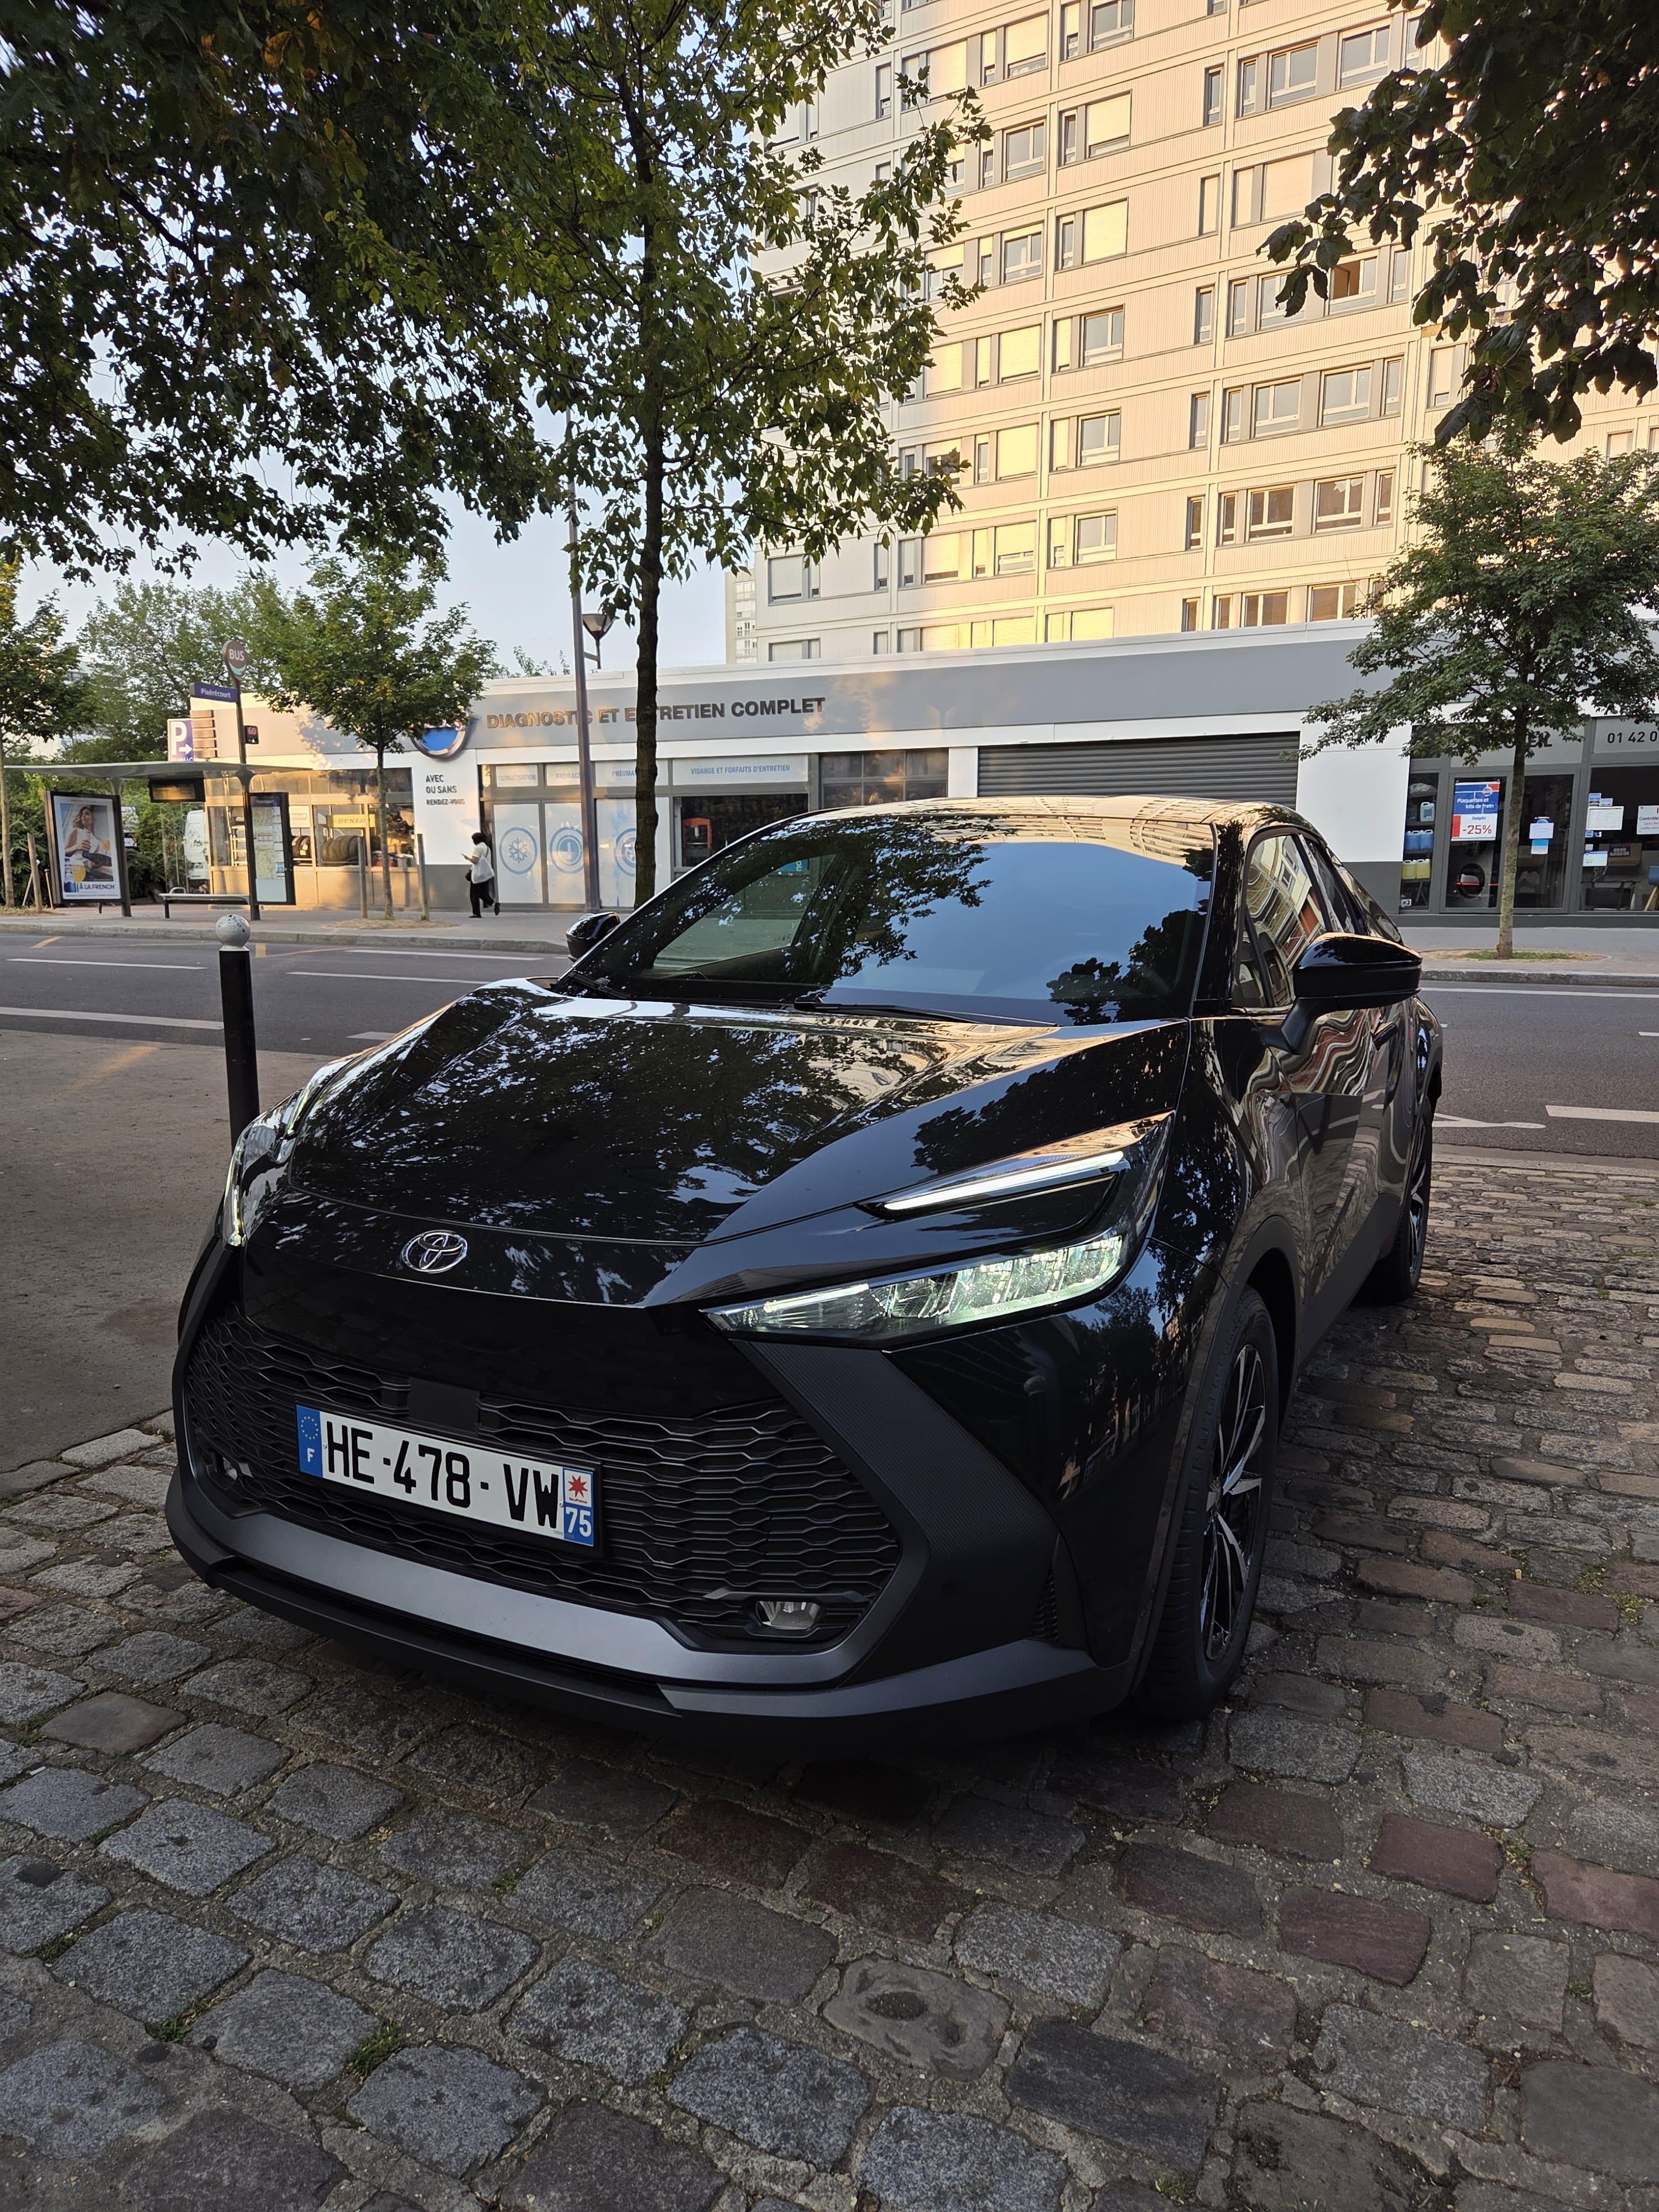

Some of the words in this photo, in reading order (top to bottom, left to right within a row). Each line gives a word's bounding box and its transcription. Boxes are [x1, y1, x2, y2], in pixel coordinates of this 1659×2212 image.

[229, 649, 244, 661] BUS
[201, 688, 231, 698] Pixérécourt
[598, 708, 619, 723] ET
[625, 703, 726, 722] ERETIEN
[731, 697, 826, 717] COMPLET
[170, 721, 187, 755] P
[1608, 732, 1622, 743] 01
[1628, 732, 1645, 743] 42
[1650, 732, 1657, 742] 0
[1463, 825, 1492, 834] -25%
[307, 1448, 314, 1463] F
[566, 1506, 592, 1537] 75
